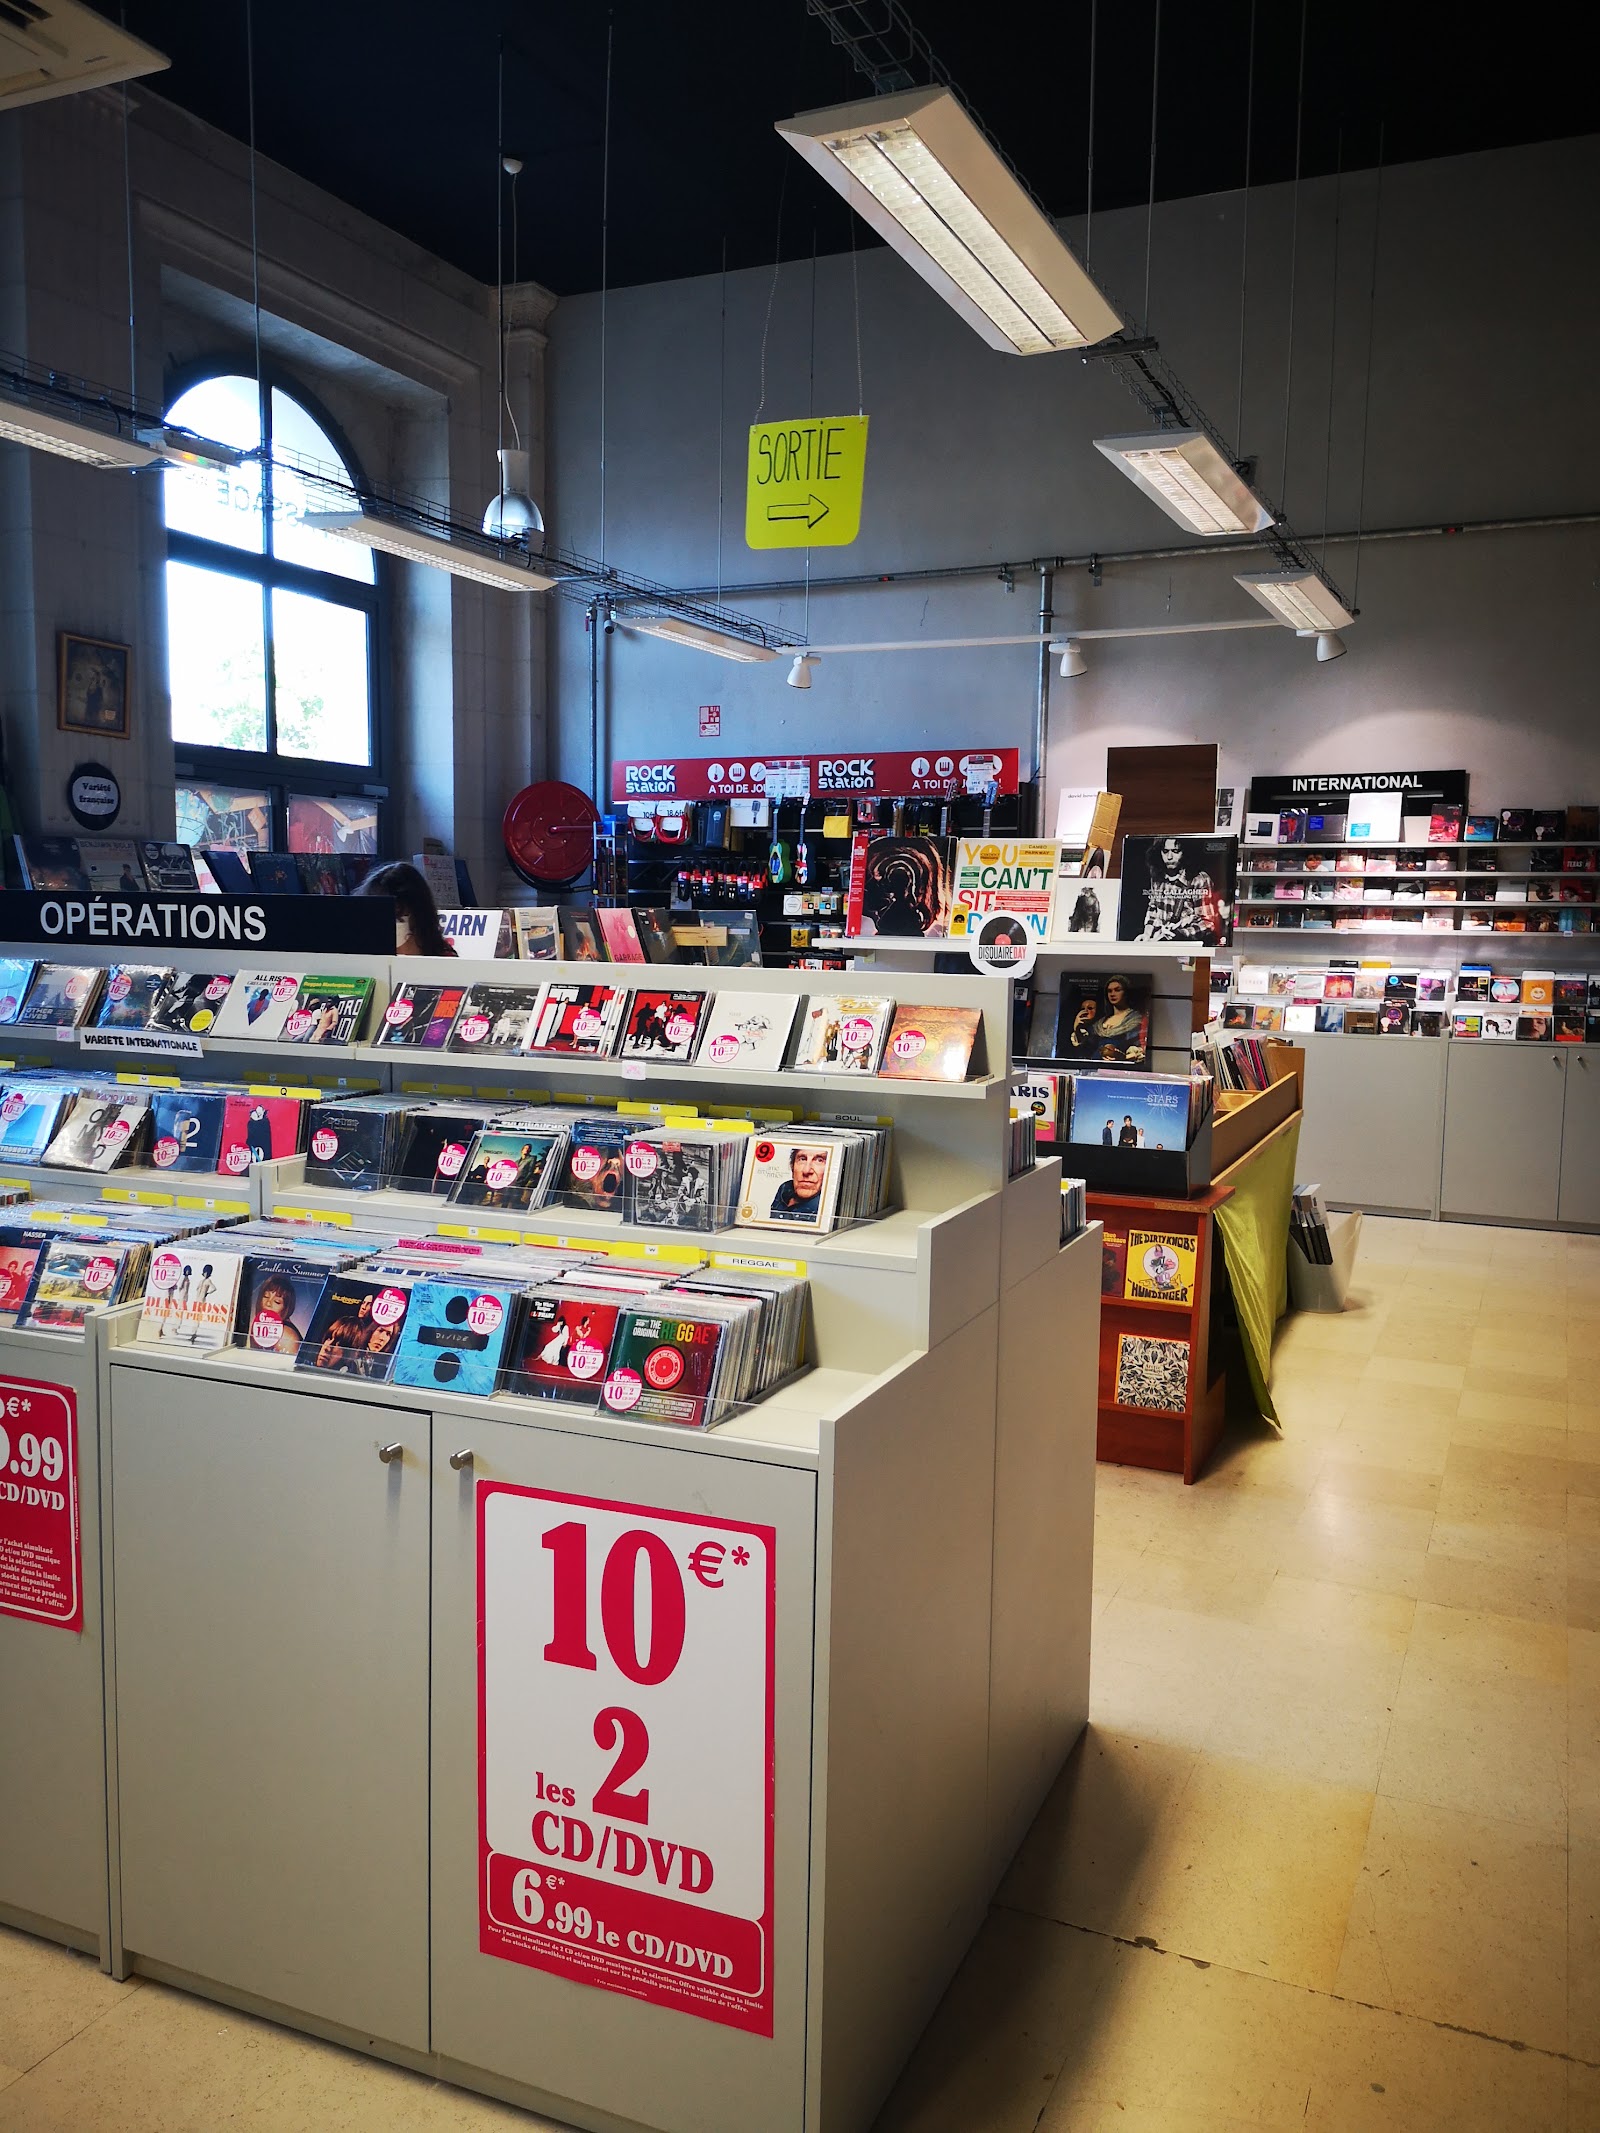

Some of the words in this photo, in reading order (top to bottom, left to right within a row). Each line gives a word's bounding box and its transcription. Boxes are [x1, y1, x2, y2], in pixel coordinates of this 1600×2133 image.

[756, 421, 845, 485] SORTIE
[625, 764, 676, 782] ROCK
[817, 759, 874, 777] ROCK
[625, 781, 676, 794] station
[708, 785, 717, 794] A
[718, 784, 735, 794] TOI
[736, 784, 749, 794] DE
[817, 776, 874, 789] station
[912, 780, 921, 790] A
[923, 779, 940, 789] TOI
[1292, 774, 1423, 792] INTERNATIONAL
[964, 843, 1018, 867] YOU
[981, 866, 1054, 890] CAN'T
[958, 889, 996, 912] SIT
[40, 896, 267, 942] OPÉRATIONS
[614, 953, 644, 963] GARBAGE
[84, 1034, 124, 1047] VARIETE
[126, 1037, 199, 1052] INTERNATIONALE
[280, 1087, 288, 1096] Q
[1010, 1085, 1050, 1099] ARIS
[834, 1114, 863, 1122] SOUL
[23, 1230, 47, 1239] NASSER
[1130, 1232, 1143, 1247] THE
[1143, 1233, 1166, 1244] DIRTY
[1166, 1236, 1195, 1253] KNOBS
[732, 1259, 779, 1268] REGGAE
[86, 1271, 100, 1282] 10
[154, 1268, 167, 1281] 10
[145, 1295, 188, 1311] DIANA
[192, 1300, 228, 1315] ROSS
[374, 1302, 389, 1316] 10
[471, 1311, 486, 1325] 10
[649, 1319, 662, 1330] THE
[256, 1325, 269, 1338] 10
[435, 1332, 470, 1342] DIVIDE
[632, 1327, 660, 1339] ORIGINAL
[660, 1321, 711, 1345] REGGAE
[570, 1355, 586, 1369] 10
[608, 1386, 623, 1400] 10
[592, 1705, 650, 1826] 2
[535, 1770, 576, 1808] les
[531, 1809, 714, 1896] CD/DVD
[596, 1920, 620, 1948] le
[626, 1930, 734, 1979] CD/DVD
[512, 1938, 531, 1950] stocks
[531, 1944, 566, 1960] disponibles
[572, 1957, 609, 1973] uniquement
[631, 1975, 658, 1987] produits
[658, 1981, 682, 1994] portant
[690, 1991, 717, 2004] mention
[522, 1935, 551, 1949] simultané
[564, 1947, 574, 1955] CD
[591, 1954, 604, 1964] DVD
[605, 1960, 632, 1971] musique
[679, 1980, 696, 1990] Offre
[696, 1983, 719, 1997] valable
[720, 1992, 736, 2002] dans
[744, 1998, 764, 2010] limite
